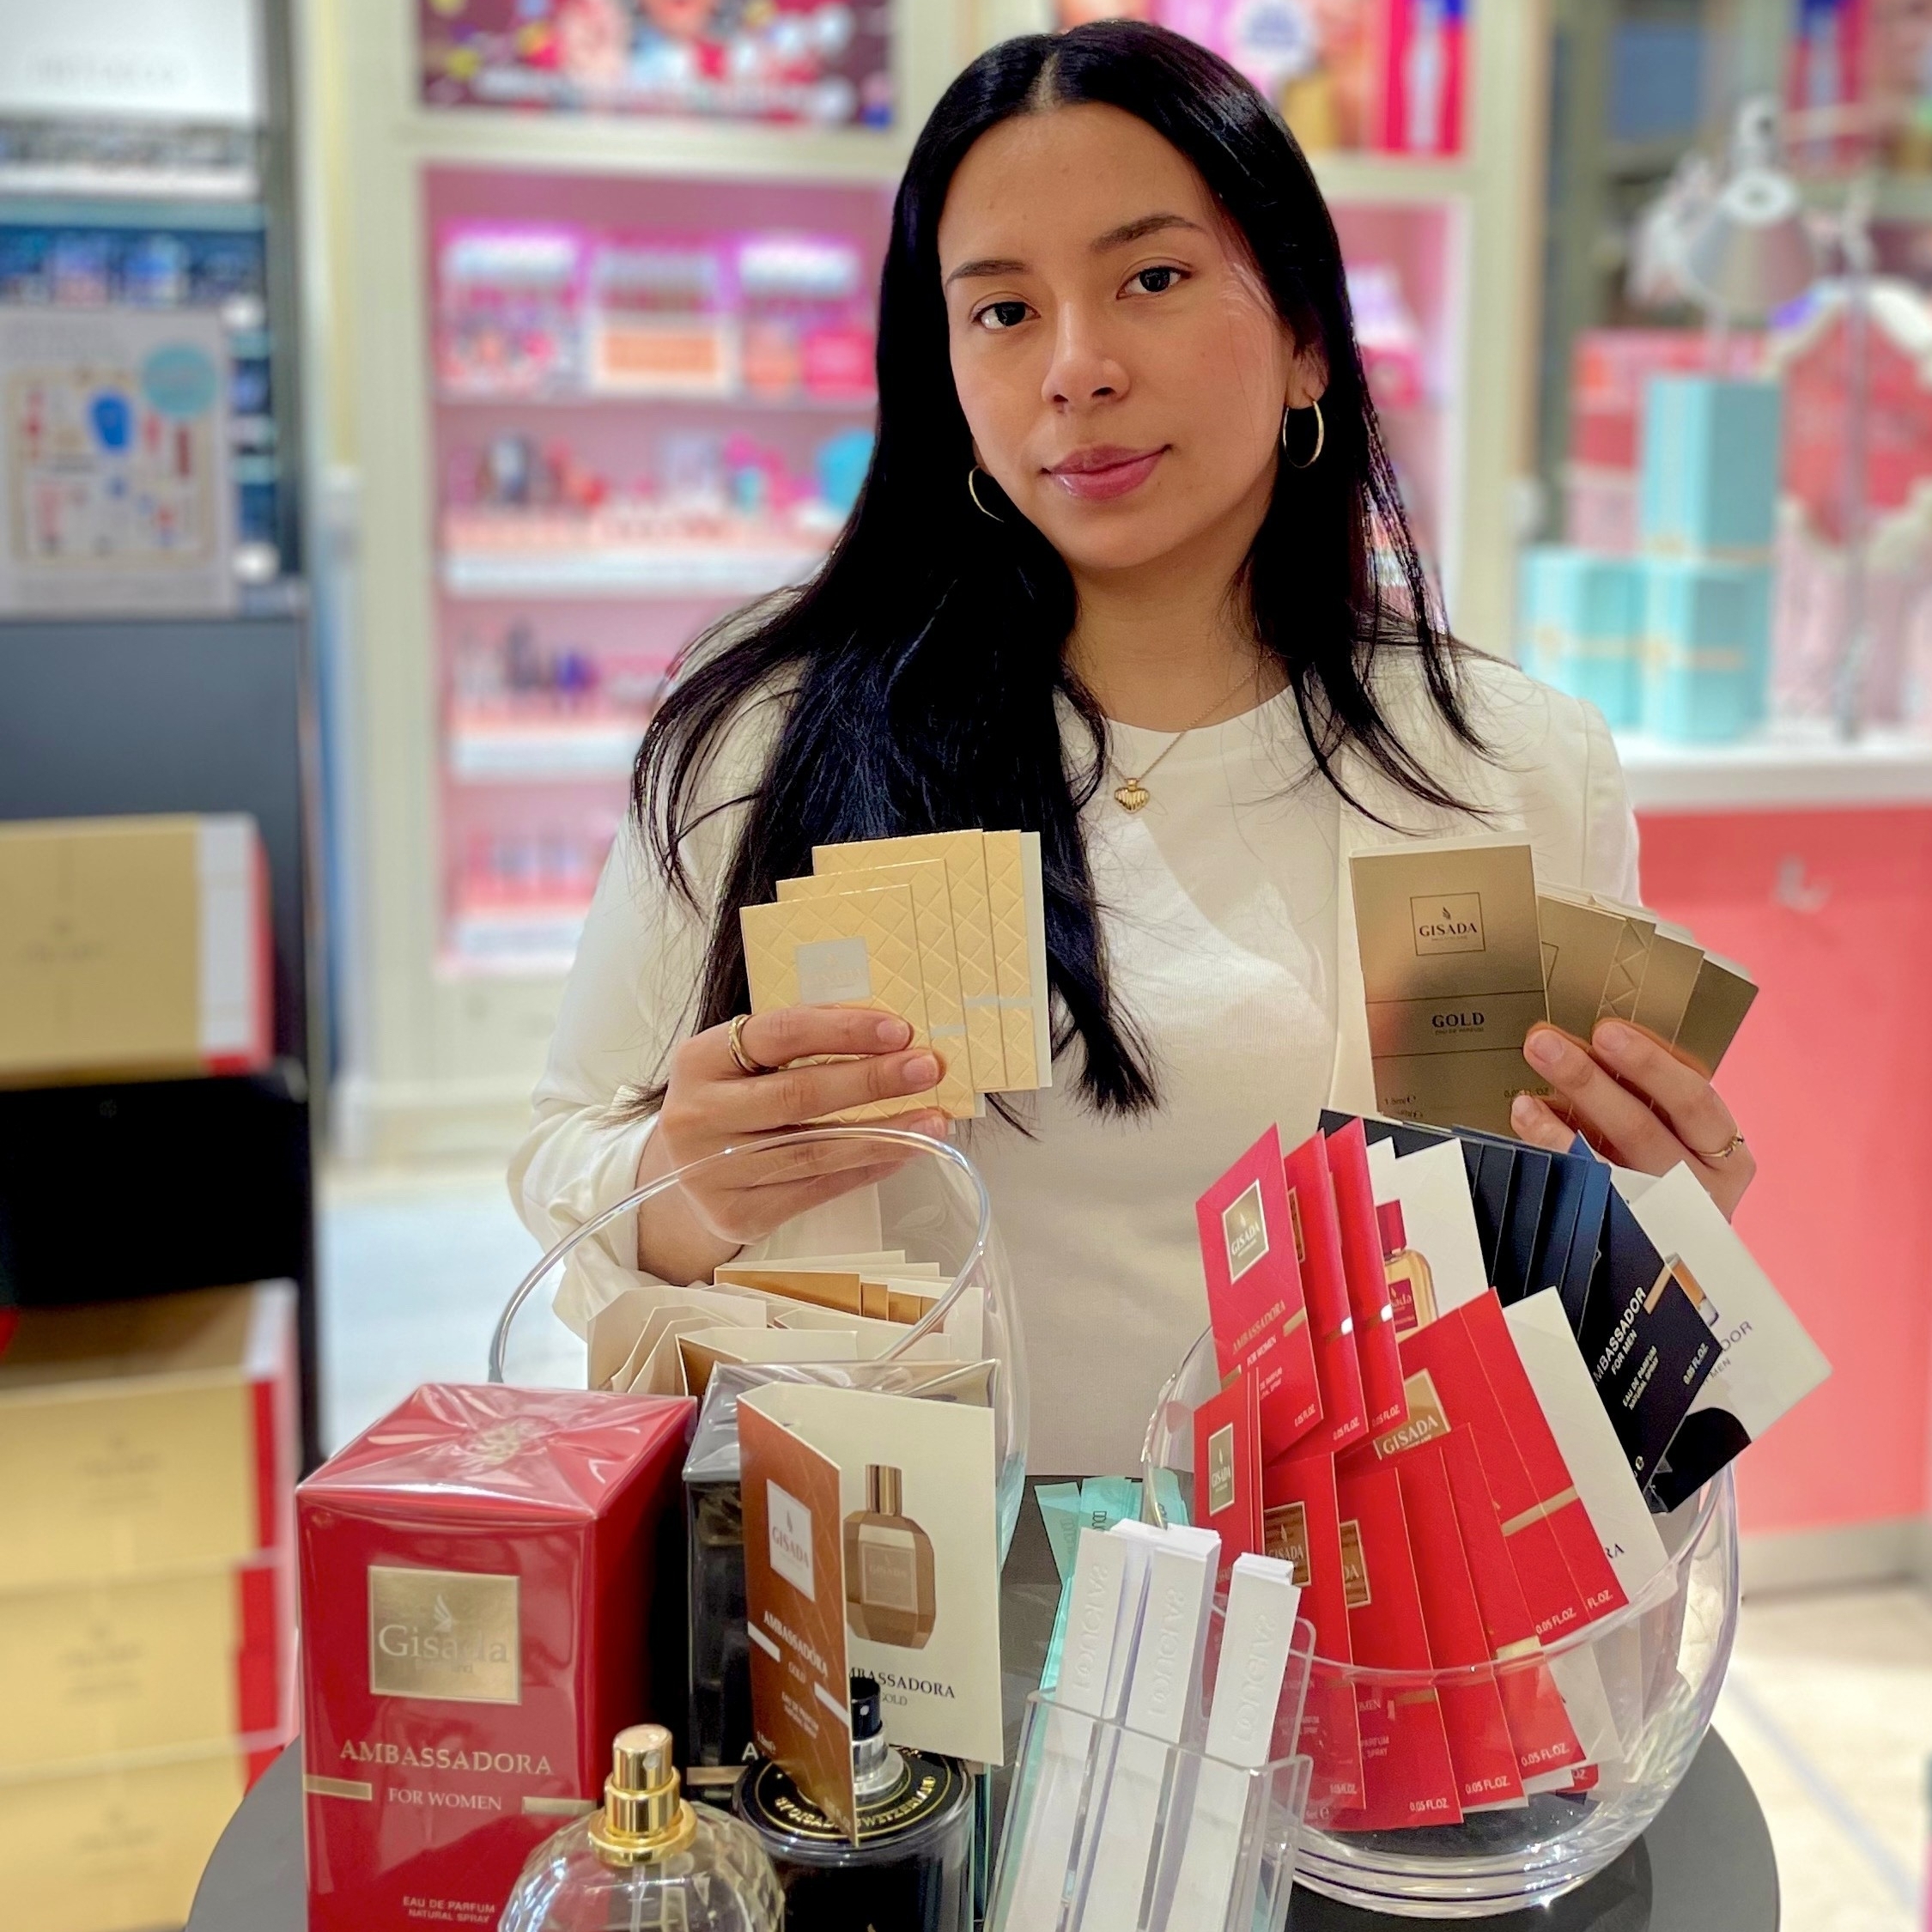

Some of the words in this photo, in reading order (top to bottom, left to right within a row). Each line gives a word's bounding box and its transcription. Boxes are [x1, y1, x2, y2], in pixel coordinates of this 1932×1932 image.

[1419, 922, 1478, 938] GISADA
[1431, 1012, 1485, 1029] GOLD
[1231, 1221, 1261, 1255] GISADA
[1592, 1286, 1647, 1383] MBASSADOR
[1611, 1351, 1625, 1376] FOR
[1622, 1328, 1637, 1355] MEN
[1382, 1414, 1439, 1455] GISADA
[773, 1526, 810, 1570] GISADA
[1534, 1619, 1552, 1635] 0.05
[378, 1623, 511, 1664] Gisada
[763, 1610, 829, 1679] AMBASSADORA
[339, 1738, 555, 1776] AMBASSADORA
[1521, 1751, 1540, 1767] 0.05
[387, 1788, 424, 1805] FOR
[428, 1791, 502, 1811] WOMEN
[1465, 1781, 1485, 1795] 0.05
[1409, 1801, 1426, 1812] 0.05
[403, 1896, 426, 1907] EAU
[429, 1899, 445, 1910] DE
[447, 1900, 495, 1913] PARFUM
[408, 1909, 453, 1922] NATURAL
[456, 1912, 490, 1923] SPRAY
